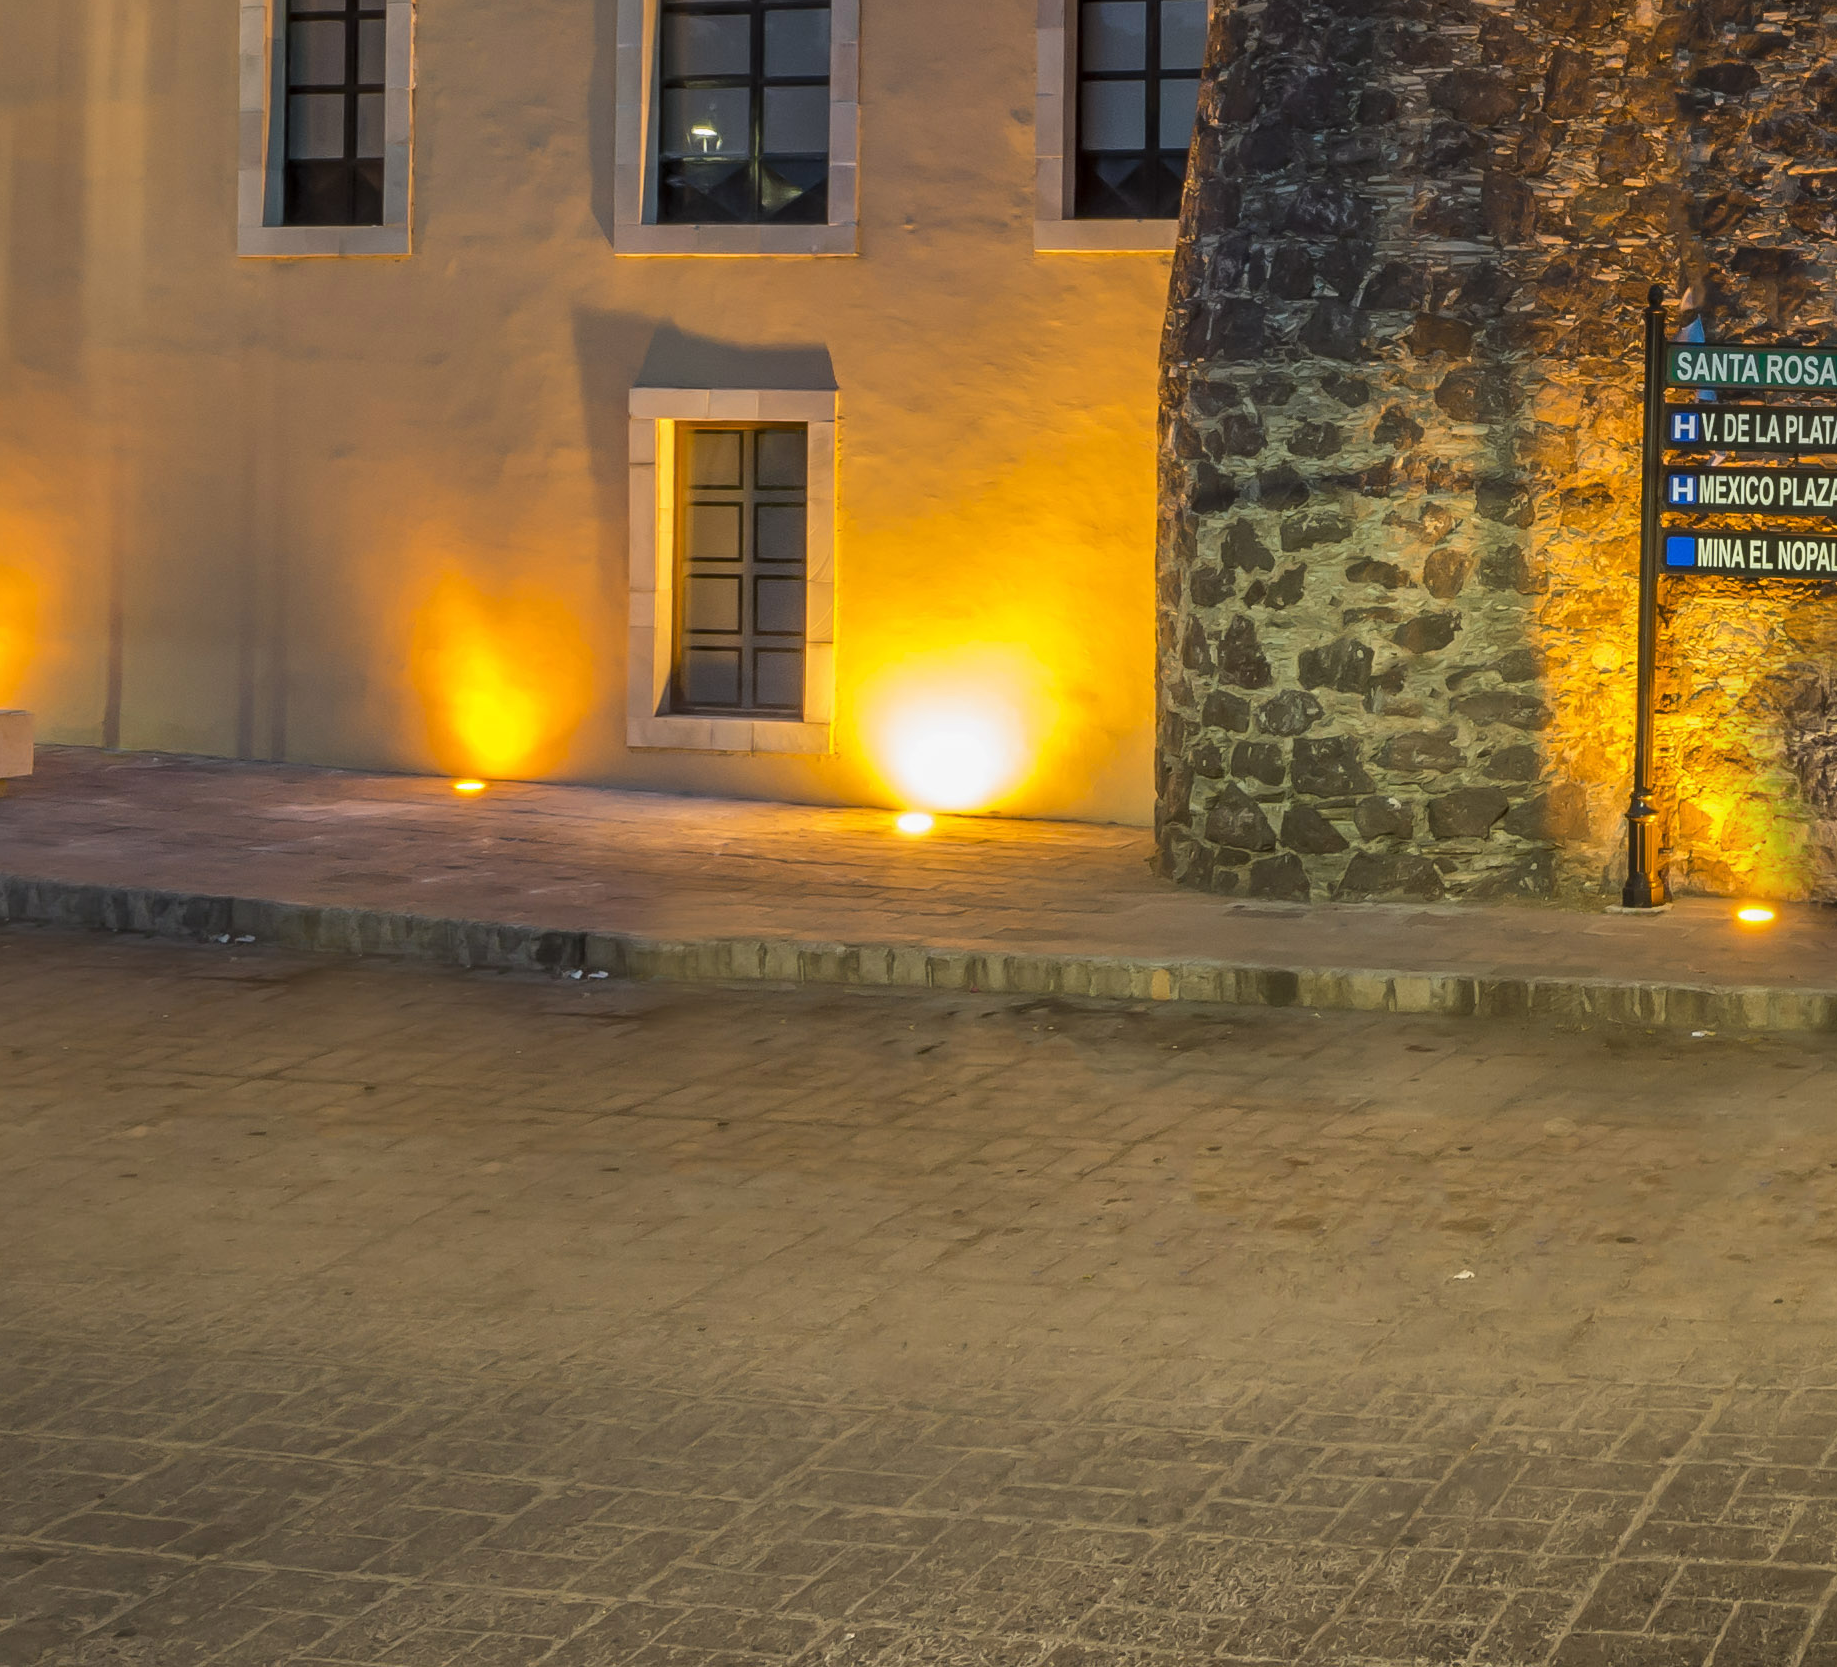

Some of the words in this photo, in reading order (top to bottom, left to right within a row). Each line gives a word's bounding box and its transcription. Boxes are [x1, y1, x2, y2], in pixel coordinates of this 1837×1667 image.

[1677, 351, 1760, 383] SANTA
[1766, 354, 1837, 386] ROSA
[1701, 413, 1718, 442] V.
[1724, 413, 1750, 443] DE
[1755, 414, 1781, 444] LA
[1699, 475, 1774, 506] MEXICO
[1697, 537, 1746, 569] MINA
[1749, 540, 1774, 570] EL
